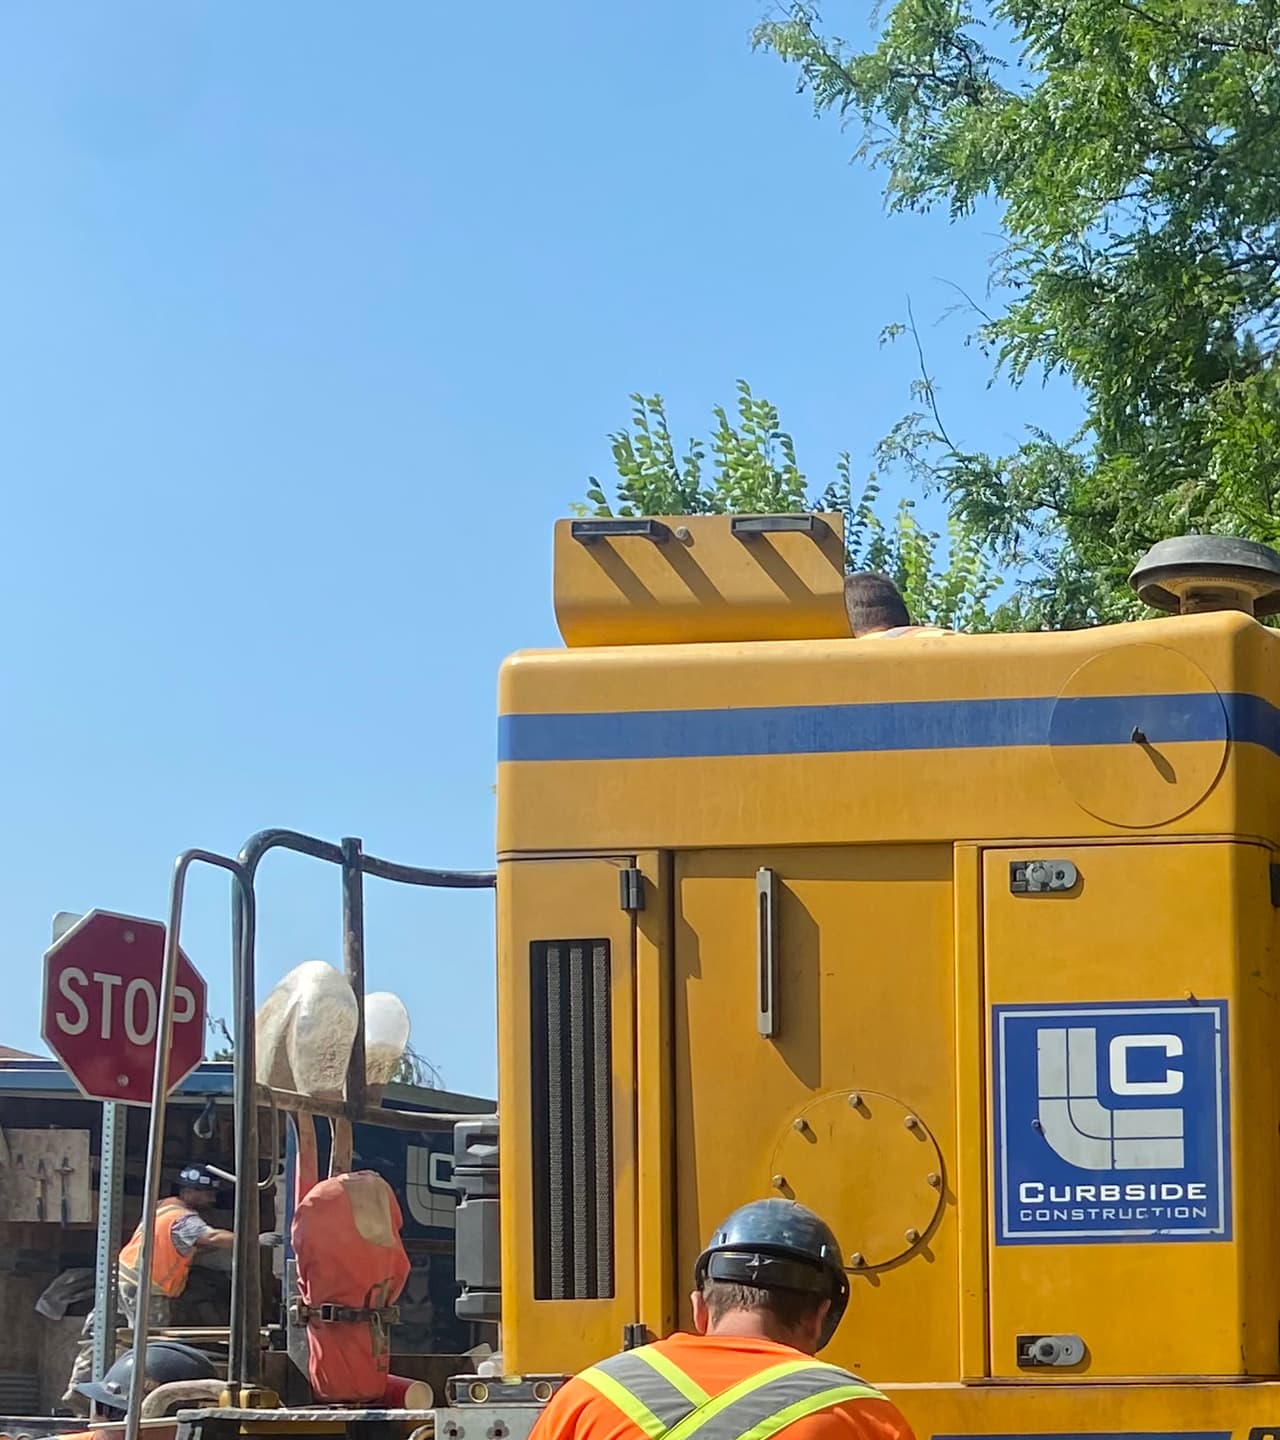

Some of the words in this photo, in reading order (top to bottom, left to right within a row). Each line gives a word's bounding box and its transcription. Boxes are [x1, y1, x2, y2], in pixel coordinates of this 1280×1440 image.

[56, 967, 196, 1049] STOP
[1019, 1182, 1207, 1204] CURBSIDE
[1020, 1207, 1207, 1222] CONSTRUCTION
